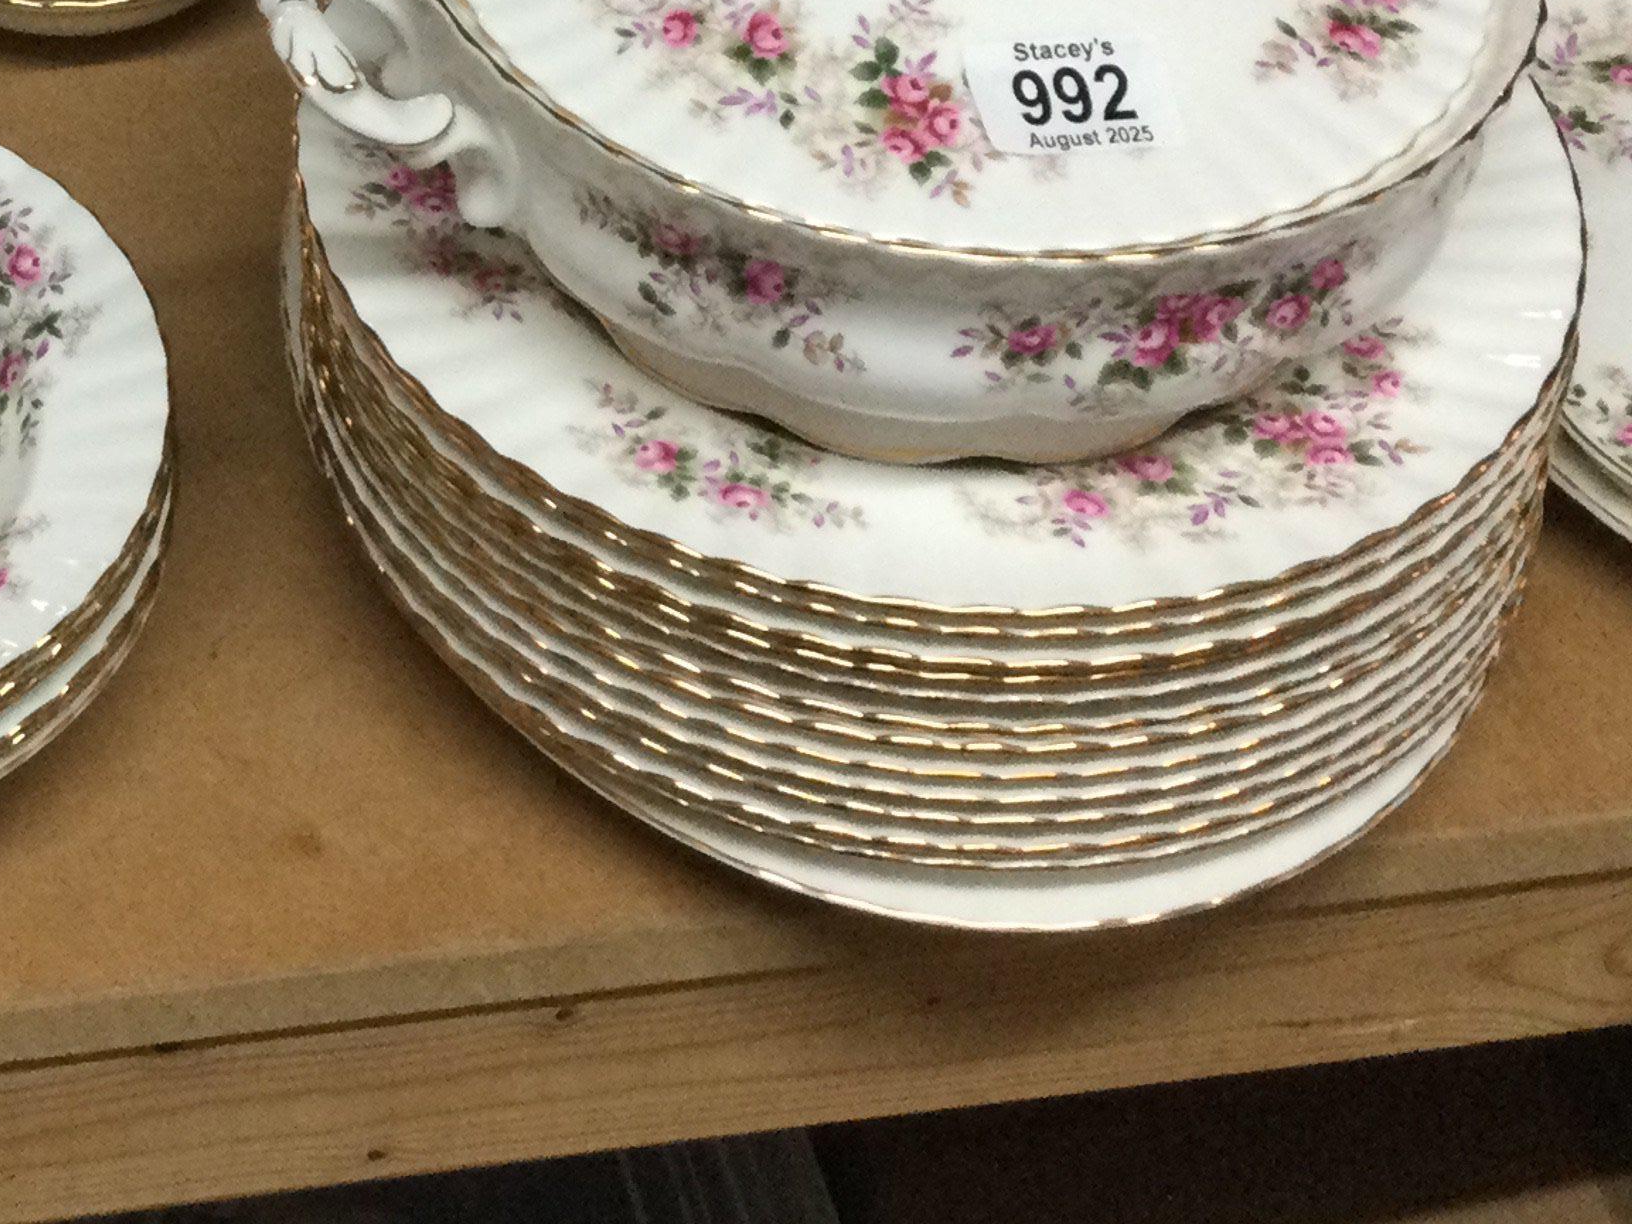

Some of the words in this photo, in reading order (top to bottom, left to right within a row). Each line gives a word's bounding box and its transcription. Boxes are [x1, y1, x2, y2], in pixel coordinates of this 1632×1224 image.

[1013, 38, 1115, 62] Stacey's
[1012, 64, 1138, 126] 992
[1029, 130, 1101, 151] August
[1106, 126, 1154, 144] 2025
